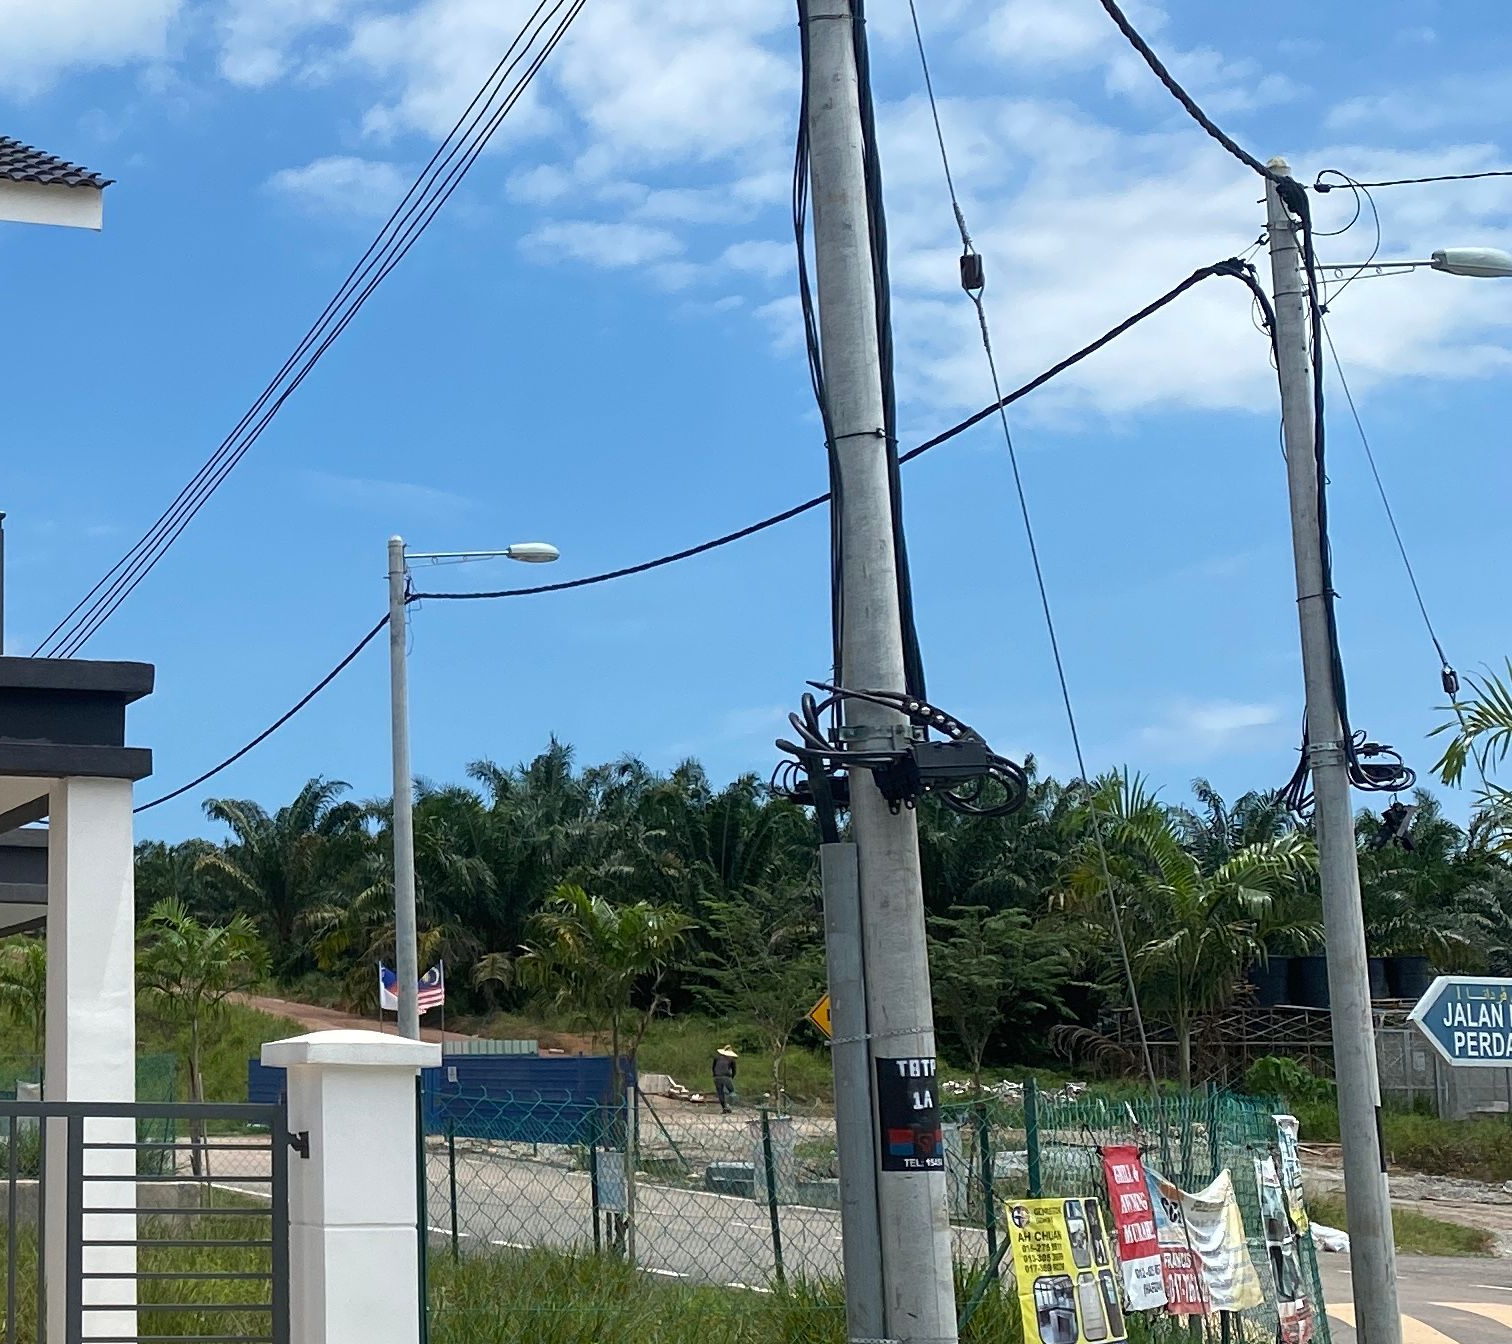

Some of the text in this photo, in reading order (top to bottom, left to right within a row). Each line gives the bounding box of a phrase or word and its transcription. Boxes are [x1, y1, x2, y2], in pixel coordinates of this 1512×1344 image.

[1443, 1002, 1504, 1028] JALAN
[913, 1090, 933, 1110] 1A
[1018, 1231, 1031, 1242] AH
